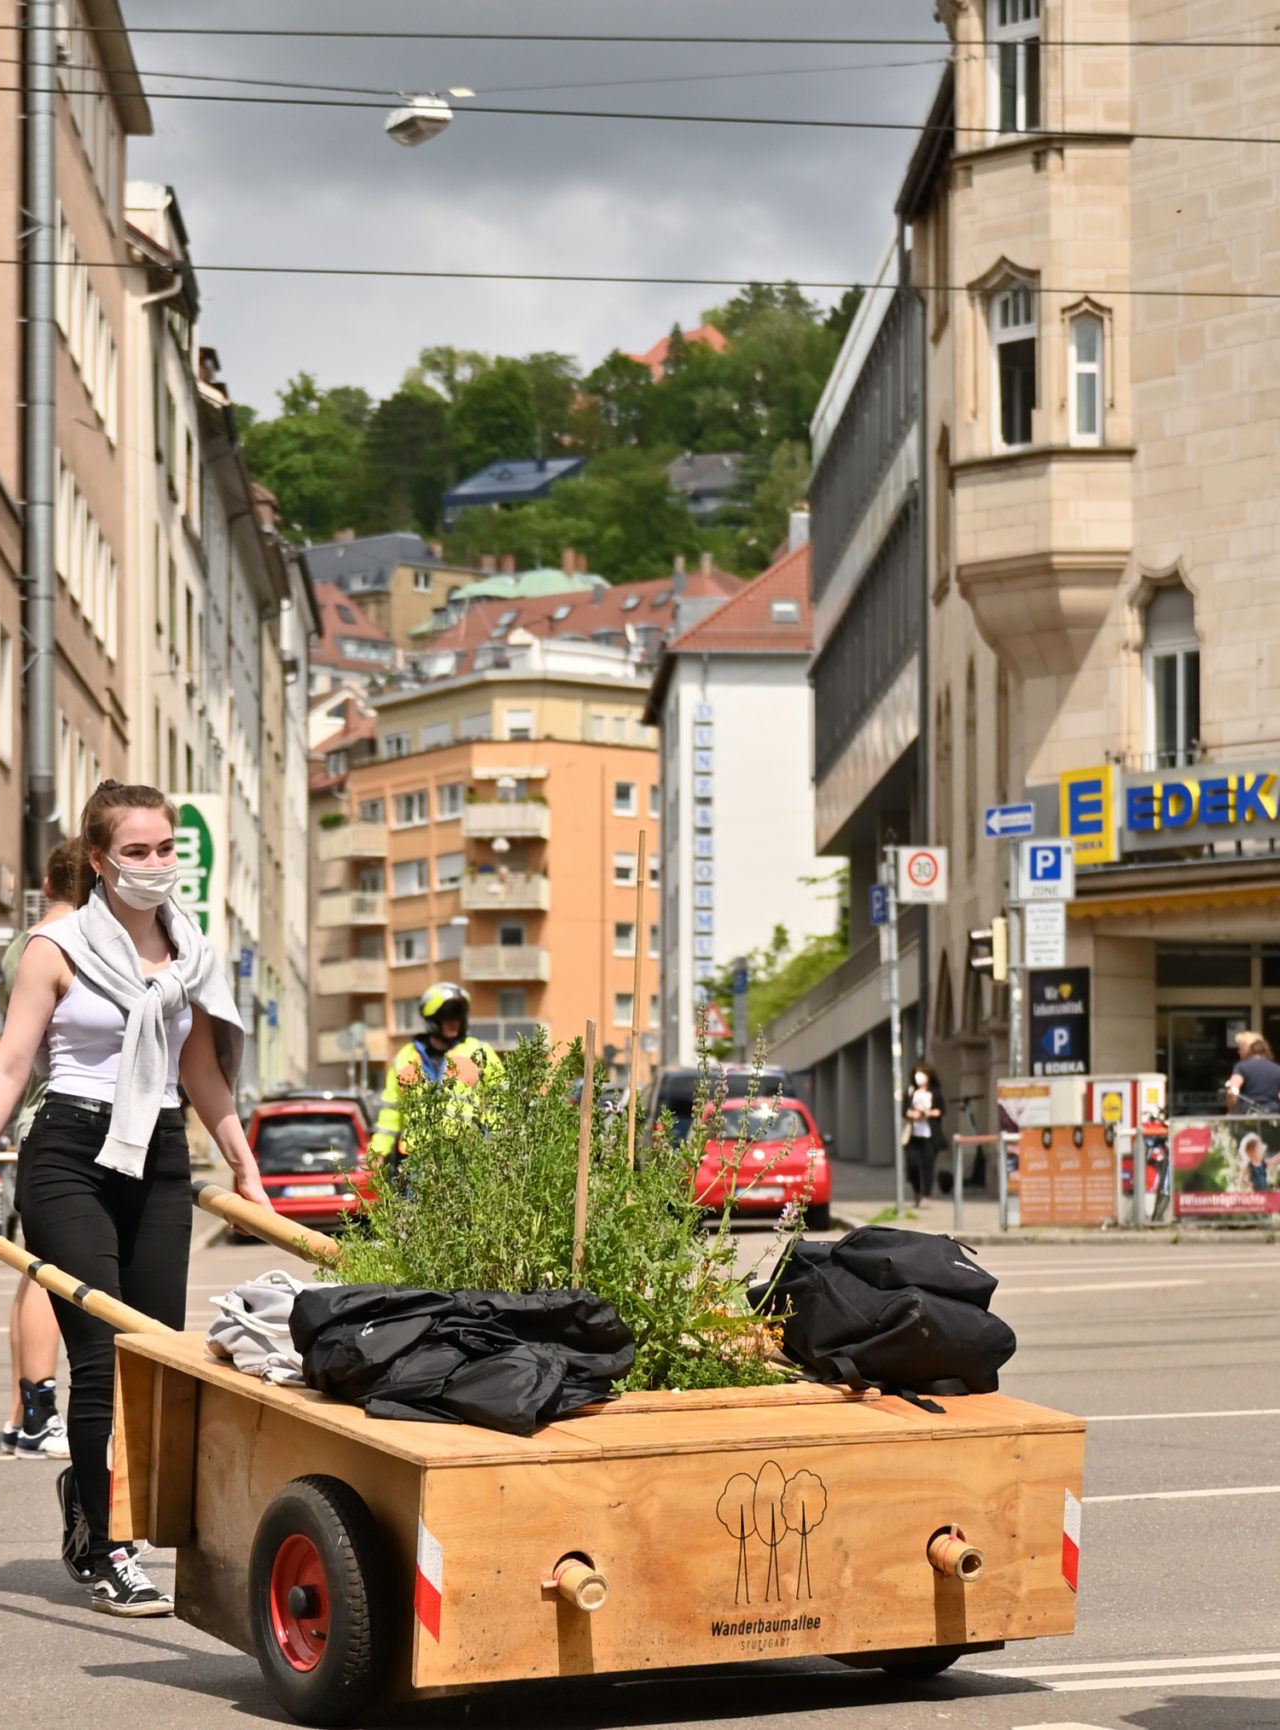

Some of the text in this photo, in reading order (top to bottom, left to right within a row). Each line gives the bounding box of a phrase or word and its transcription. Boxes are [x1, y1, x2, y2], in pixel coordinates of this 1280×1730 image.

[1126, 773, 1280, 831] EDEK
[913, 861, 932, 878] 30
[1036, 849, 1055, 878] P
[1053, 1028, 1070, 1055] P
[1045, 1060, 1085, 1075] EDEKA
[711, 1612, 821, 1637] Wanderbaumallee
[739, 1637, 790, 1651] STUTTGART
